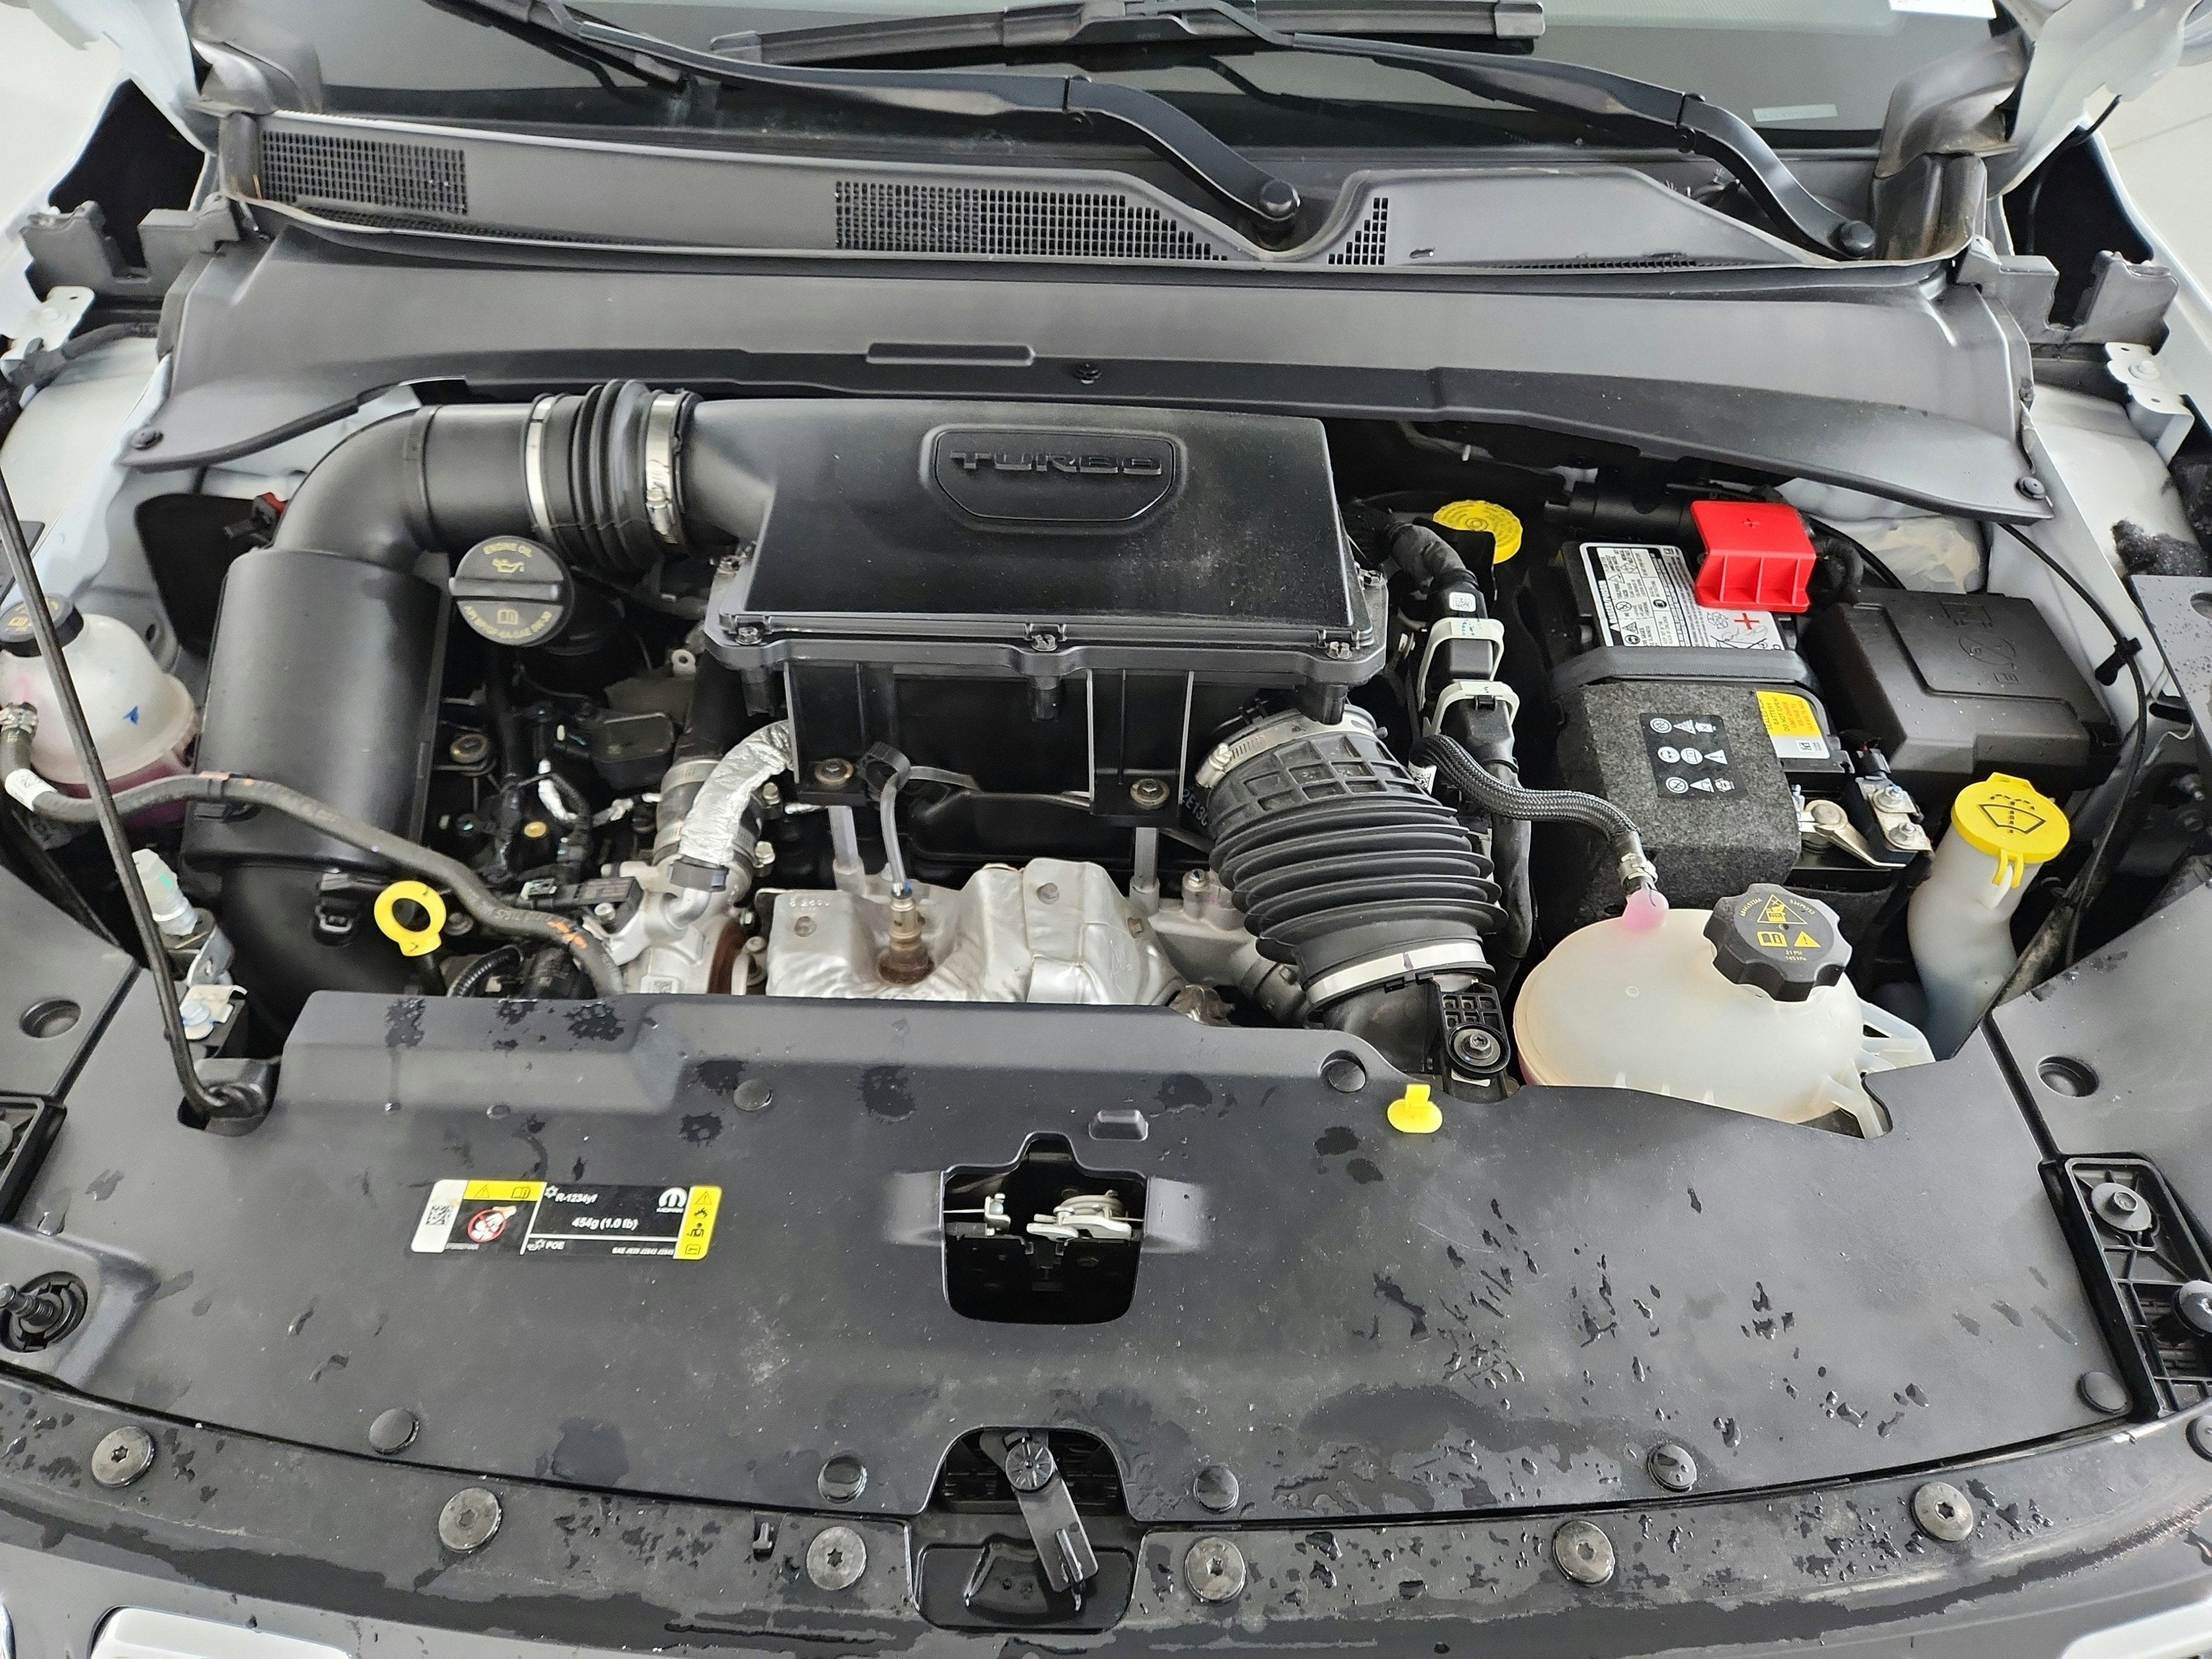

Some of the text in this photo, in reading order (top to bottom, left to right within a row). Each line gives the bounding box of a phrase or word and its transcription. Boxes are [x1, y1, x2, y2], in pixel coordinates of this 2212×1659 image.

[950, 452, 1163, 476] TURBO
[483, 541, 532, 557] ENGINE OIL
[1598, 580, 1618, 623] DANGER/POISON
[1767, 702, 1779, 725] BATTERY
[1778, 713, 1786, 723] NOT
[555, 1192, 598, 1205] R-1234yf
[571, 1217, 639, 1231] 454g (1.0 lb)
[545, 1240, 565, 1250] POE
